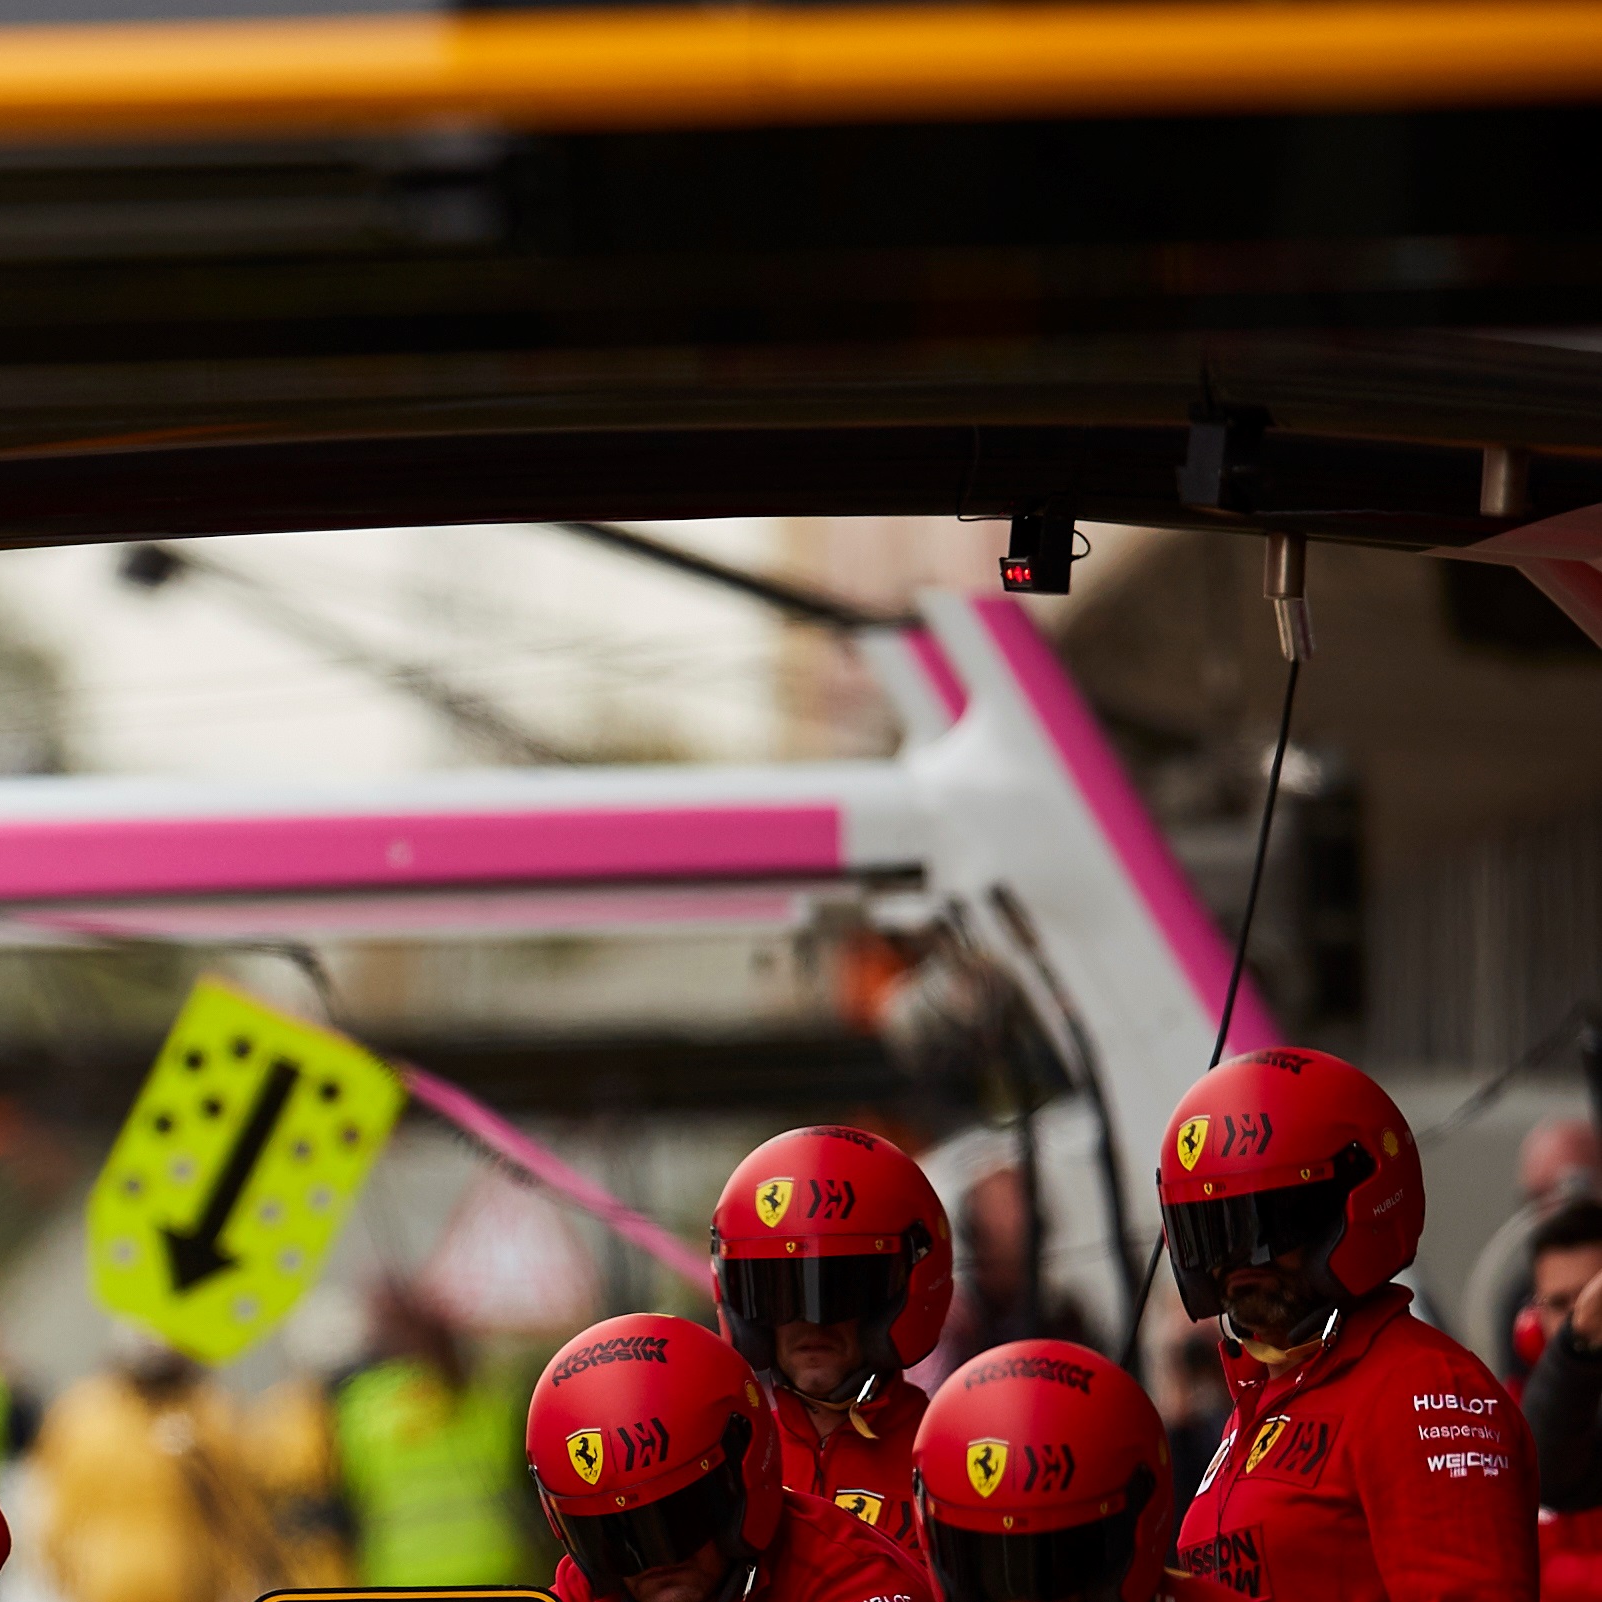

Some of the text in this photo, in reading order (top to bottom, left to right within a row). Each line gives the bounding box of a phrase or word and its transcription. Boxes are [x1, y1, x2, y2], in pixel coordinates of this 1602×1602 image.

[1373, 1189, 1404, 1216] HUBLOT
[1413, 1393, 1498, 1415] HUBLOT
[1418, 1424, 1500, 1443] kaspersky
[1427, 1451, 1509, 1472] WEICHAI
